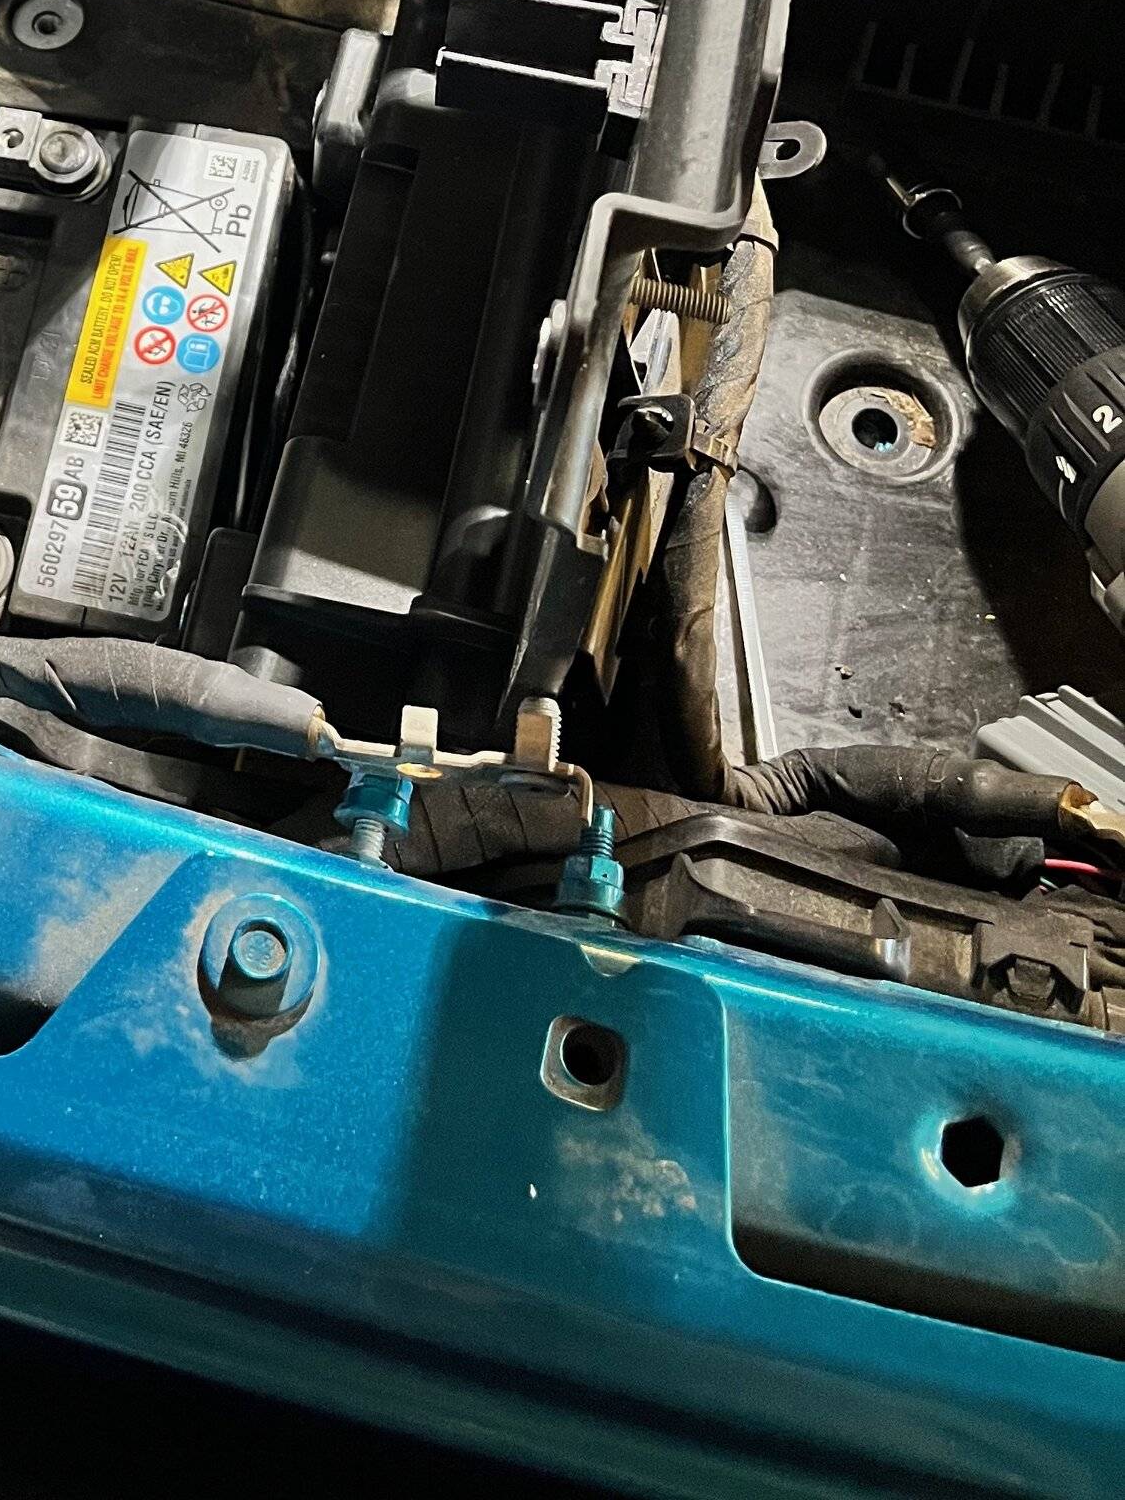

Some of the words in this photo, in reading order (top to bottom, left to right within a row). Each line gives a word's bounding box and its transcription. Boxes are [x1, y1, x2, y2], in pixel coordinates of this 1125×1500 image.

[224, 202, 252, 237] Pb
[104, 314, 123, 347] VOLTAGE
[80, 355, 97, 384] SEALED
[96, 347, 114, 378] CHARGE
[91, 378, 107, 399] LIMIT
[146, 380, 175, 445] (SAE/EN)
[1093, 405, 1122, 433] 2
[135, 448, 157, 480] CCA
[174, 449, 187, 463] MI
[128, 482, 150, 511] 200
[136, 547, 150, 566] FCA
[145, 512, 159, 530] LLC
[106, 572, 129, 603] 12V
